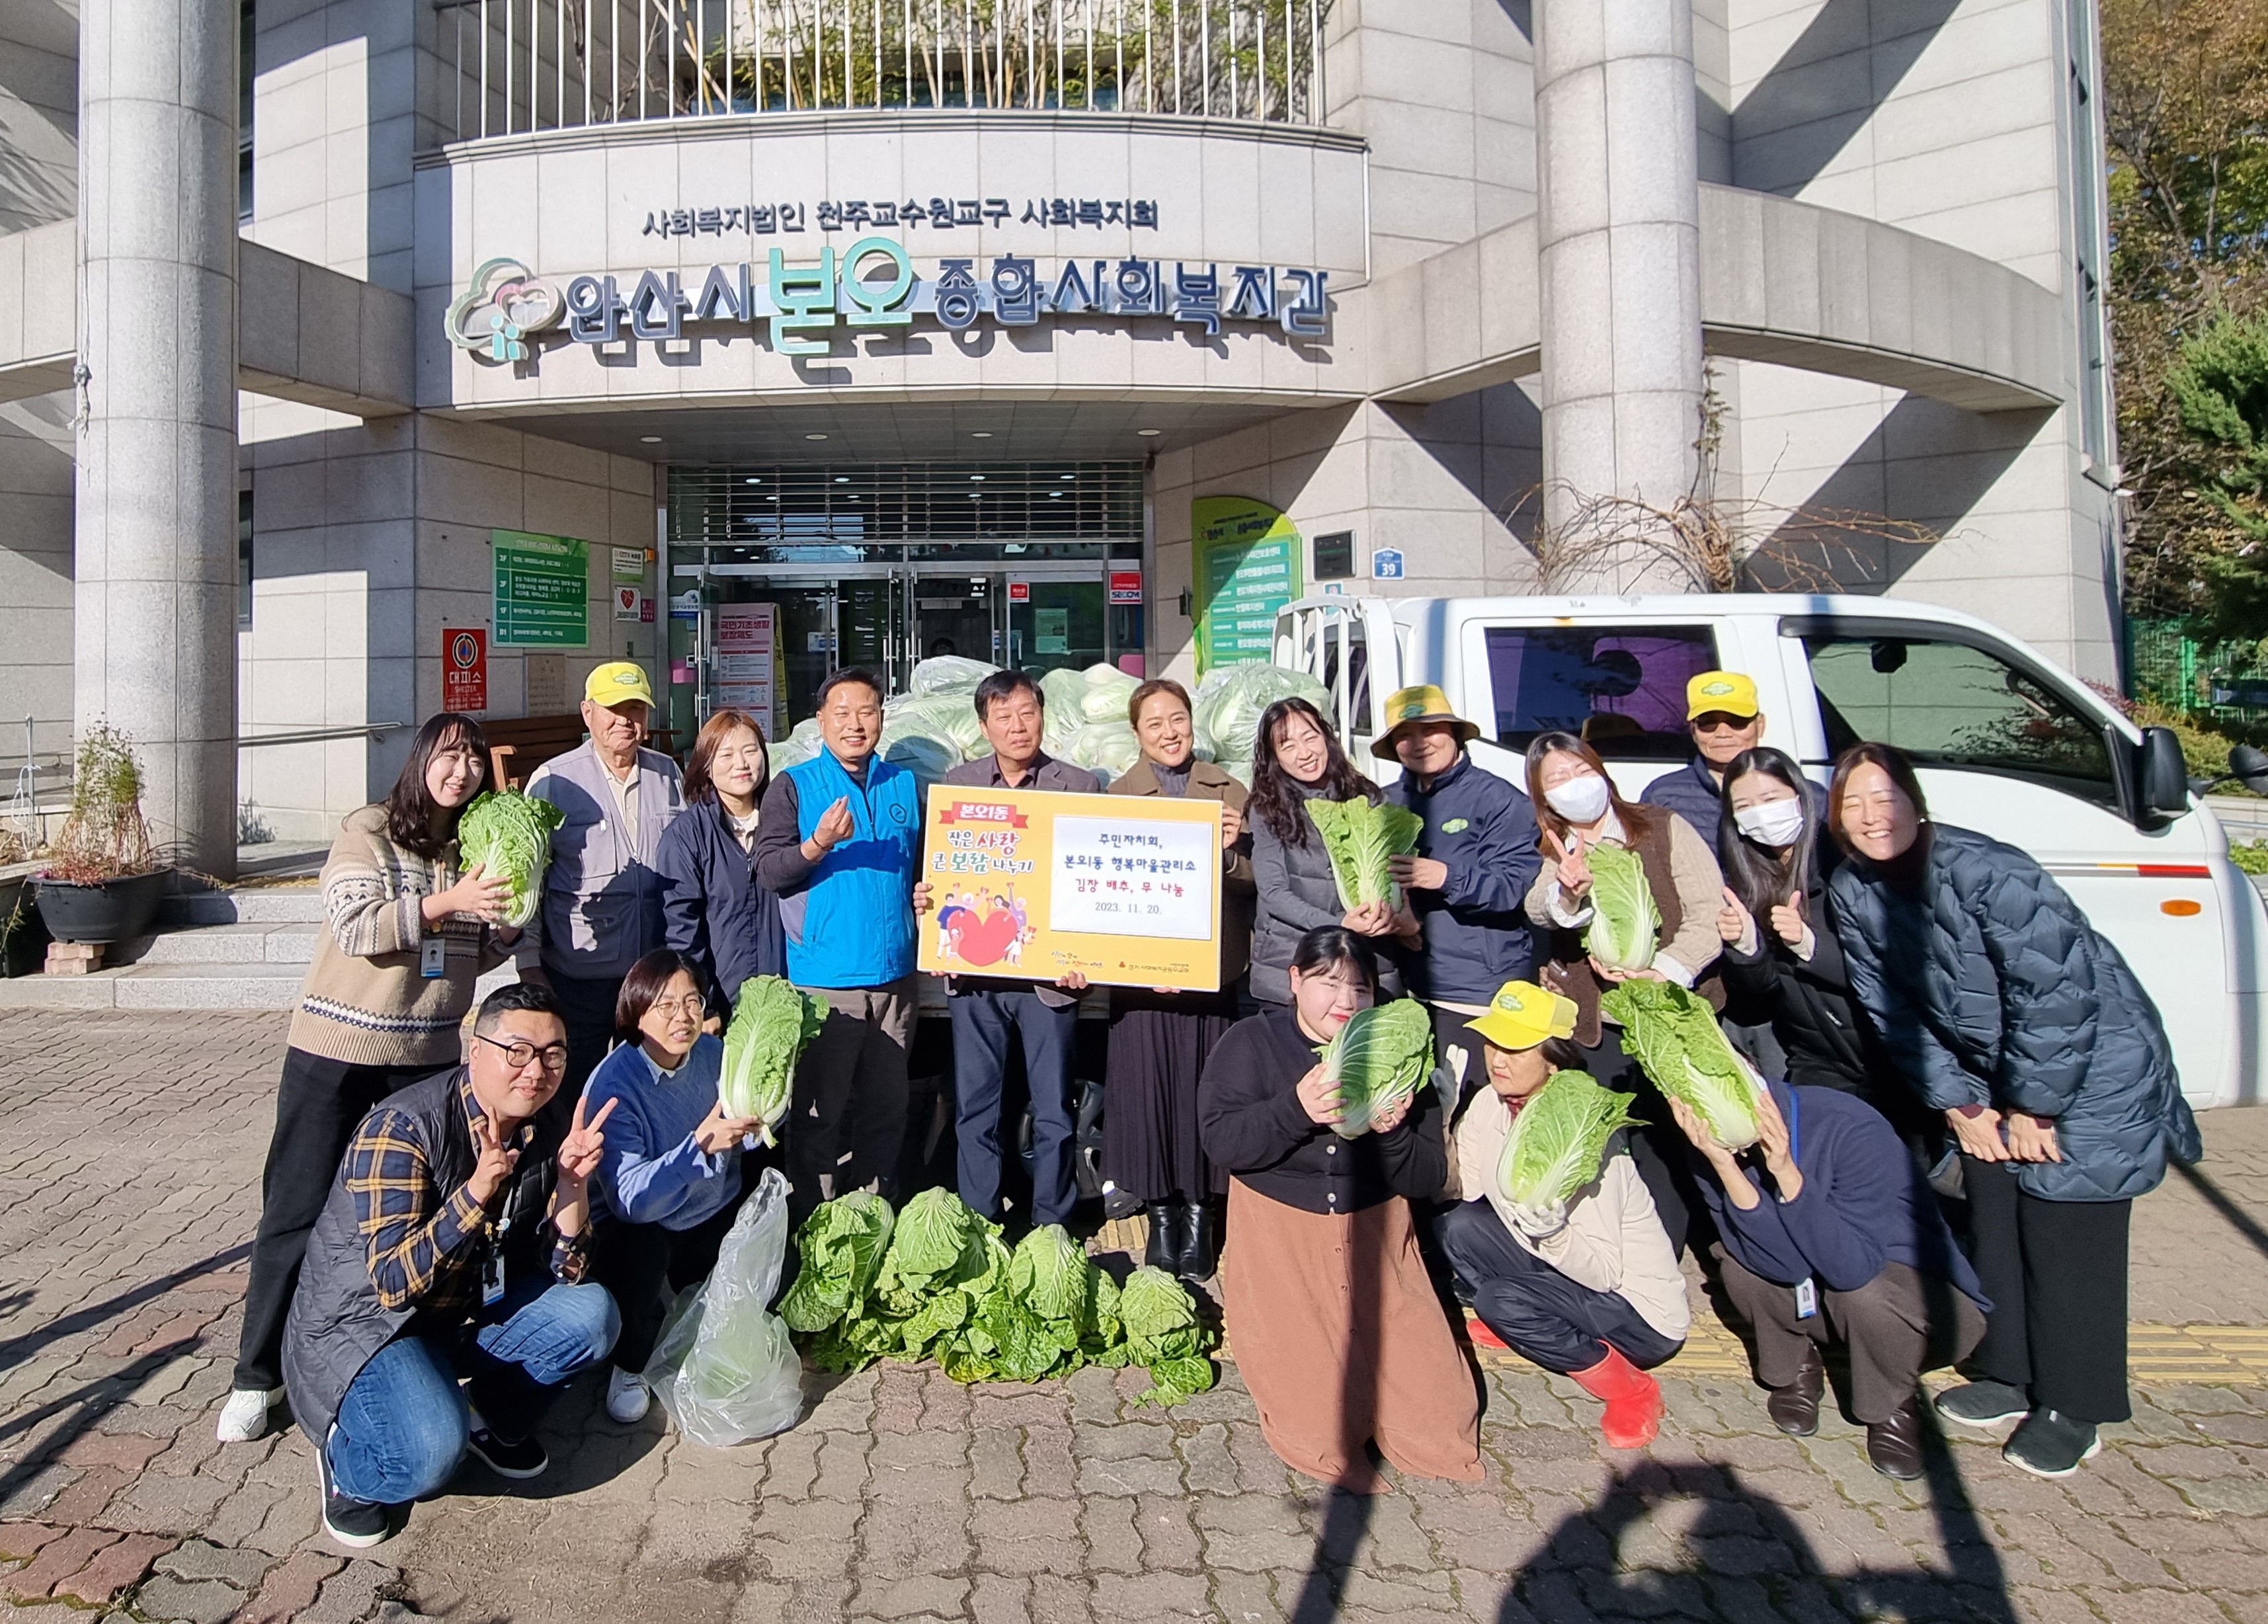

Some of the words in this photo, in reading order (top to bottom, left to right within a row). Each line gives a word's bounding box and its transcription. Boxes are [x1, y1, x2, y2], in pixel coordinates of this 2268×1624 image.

[642, 201, 805, 239] 사회복지법인
[815, 198, 1012, 231] 천주교수원교구
[1020, 198, 1158, 231] 사회복지회
[566, 262, 754, 342] 안산시
[768, 236, 913, 355] 본오
[934, 252, 1328, 336] 종합사회복지관
[1382, 563, 1396, 576] 39
[720, 620, 770, 629] 국민기초생활
[720, 631, 753, 639] 보장제도
[449, 671, 481, 684] 대피소
[959, 803, 1010, 821] 본오1동
[948, 831, 973, 848] 작은
[976, 832, 1020, 856] 사랑
[1098, 833, 1162, 850] 주민자치회,
[933, 852, 946, 870] 큰
[952, 852, 989, 872] 보람
[992, 859, 1033, 873] 나누기
[1064, 854, 1104, 870] 본오1동
[1111, 856, 1196, 874] 행복마을관리소
[1075, 878, 1099, 893] 김장
[1106, 879, 1133, 894] 배추,
[1141, 881, 1152, 893] 무
[1161, 882, 1184, 898] 나눔
[1095, 901, 1121, 913] 2023.
[1128, 903, 1142, 913] 11.
[1147, 905, 1162, 914] 20.
